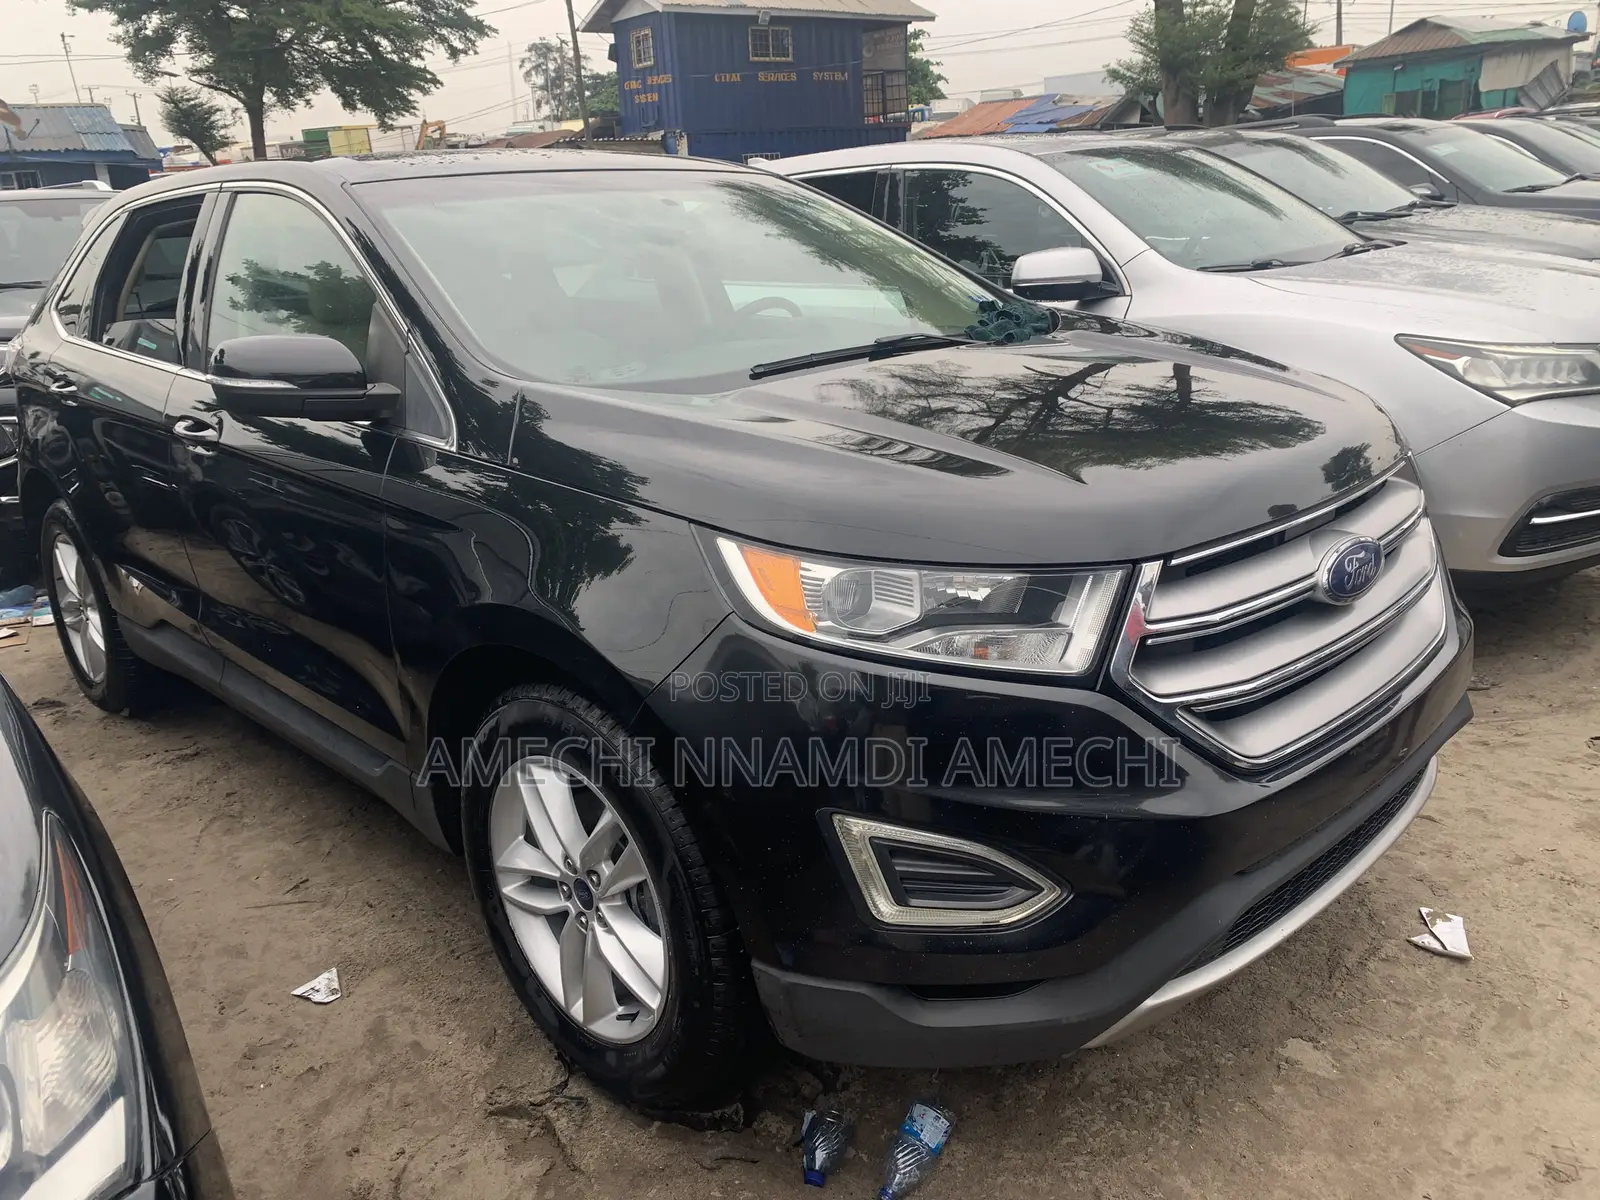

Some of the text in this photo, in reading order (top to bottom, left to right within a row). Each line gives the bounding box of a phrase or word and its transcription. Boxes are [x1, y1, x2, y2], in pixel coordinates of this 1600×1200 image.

[757, 71, 797, 82] SERVICES
[812, 71, 848, 81] SYSTEM
[1344, 550, 1377, 591] Ford
